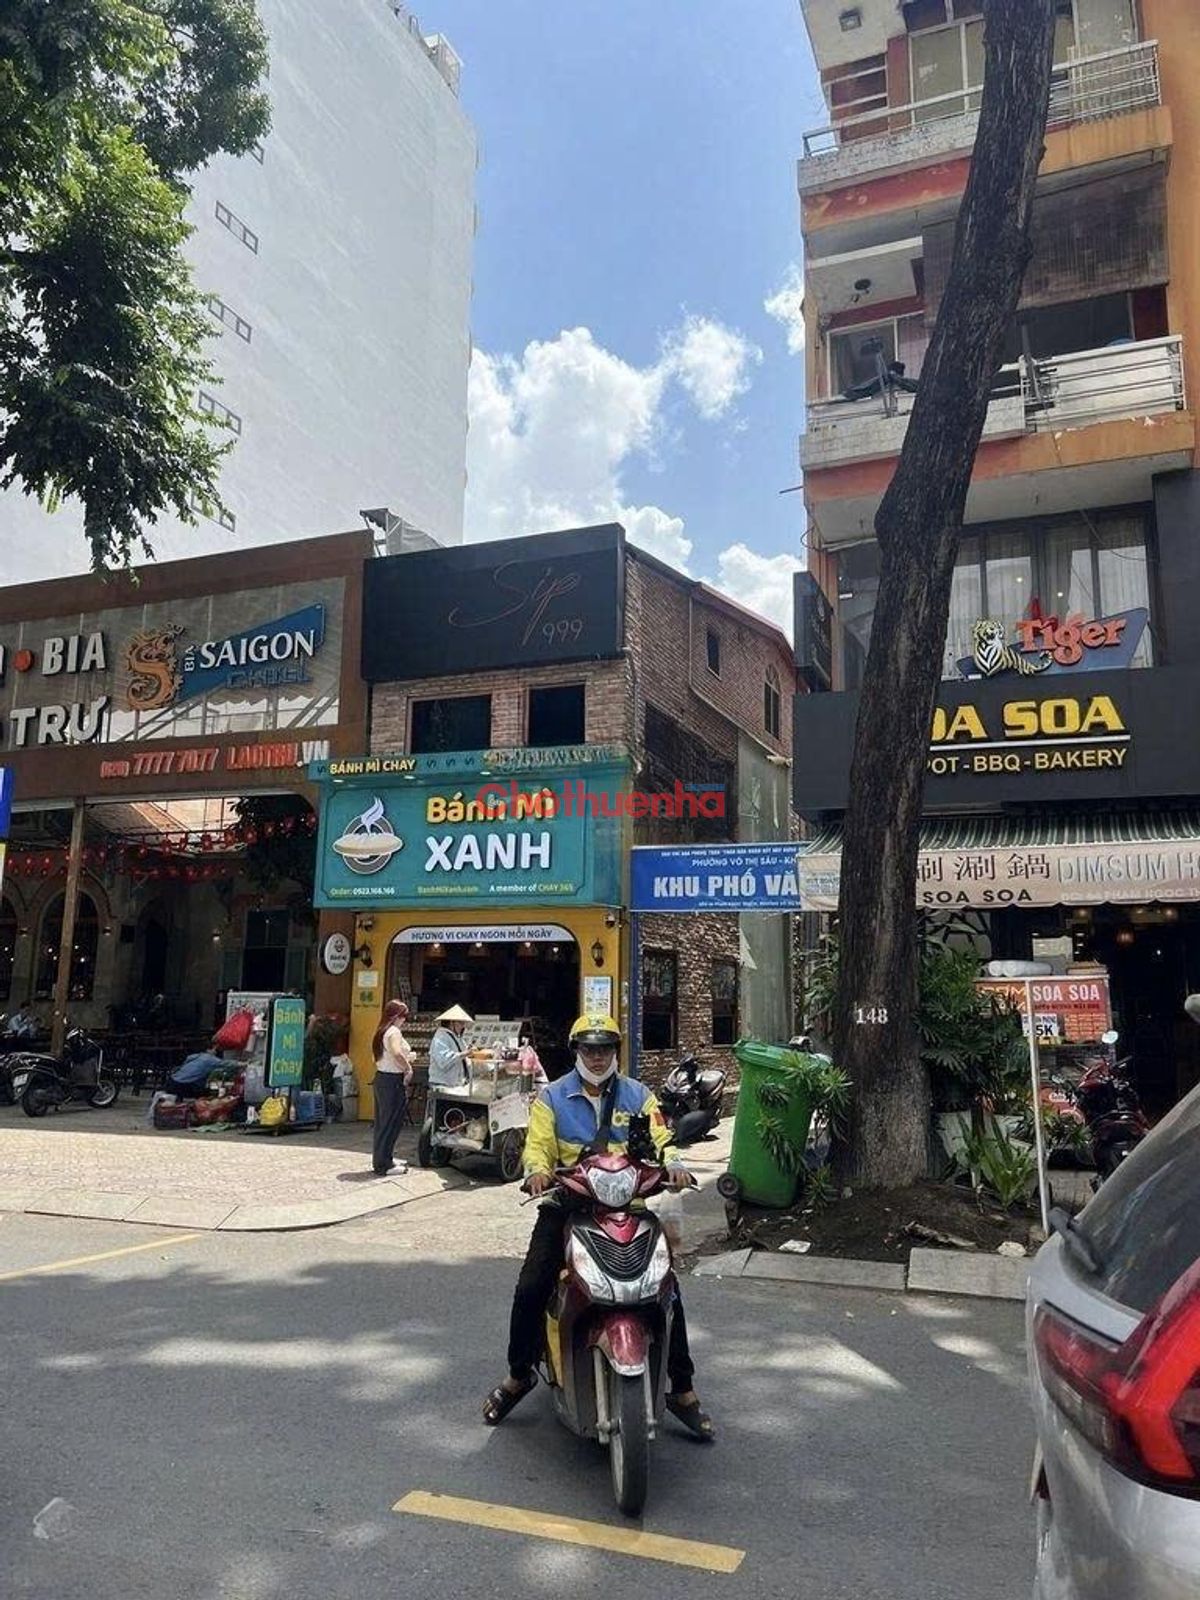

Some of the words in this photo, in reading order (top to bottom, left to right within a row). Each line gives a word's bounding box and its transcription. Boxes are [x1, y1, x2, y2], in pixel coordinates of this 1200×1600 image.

[542, 619, 583, 644] 999
[1017, 617, 1126, 665] Tiger
[42, 632, 106, 675] BIA
[184, 645, 196, 672] BIA
[200, 630, 315, 668] SAIGON
[9, 695, 107, 746] TRƯ
[1003, 696, 1125, 737] SOA
[329, 760, 363, 775] BÁNH
[365, 758, 381, 773] MÌ
[382, 758, 417, 772] CHAY
[927, 756, 960, 774] OT
[973, 755, 1021, 772] BBQ
[1034, 748, 1127, 770] BAKERY
[426, 791, 506, 824] Bánh
[517, 787, 555, 820] Mì
[424, 832, 551, 872] XANH
[1057, 856, 1167, 883] DIMSUM
[1176, 853, 1200, 880] H
[496, 884, 526, 893] member
[527, 883, 538, 892] of
[654, 876, 700, 898] KHU
[707, 868, 756, 897] PHỐ
[764, 871, 799, 896] VĂ
[922, 890, 970, 903] SOA
[982, 889, 1032, 902] SOA
[1032, 985, 1063, 1001] SOA
[1068, 984, 1100, 1000] SOA
[276, 1007, 306, 1025] Bánh
[856, 1008, 888, 1024] 148
[282, 1031, 297, 1049] Mì
[274, 1058, 303, 1077] Chay
